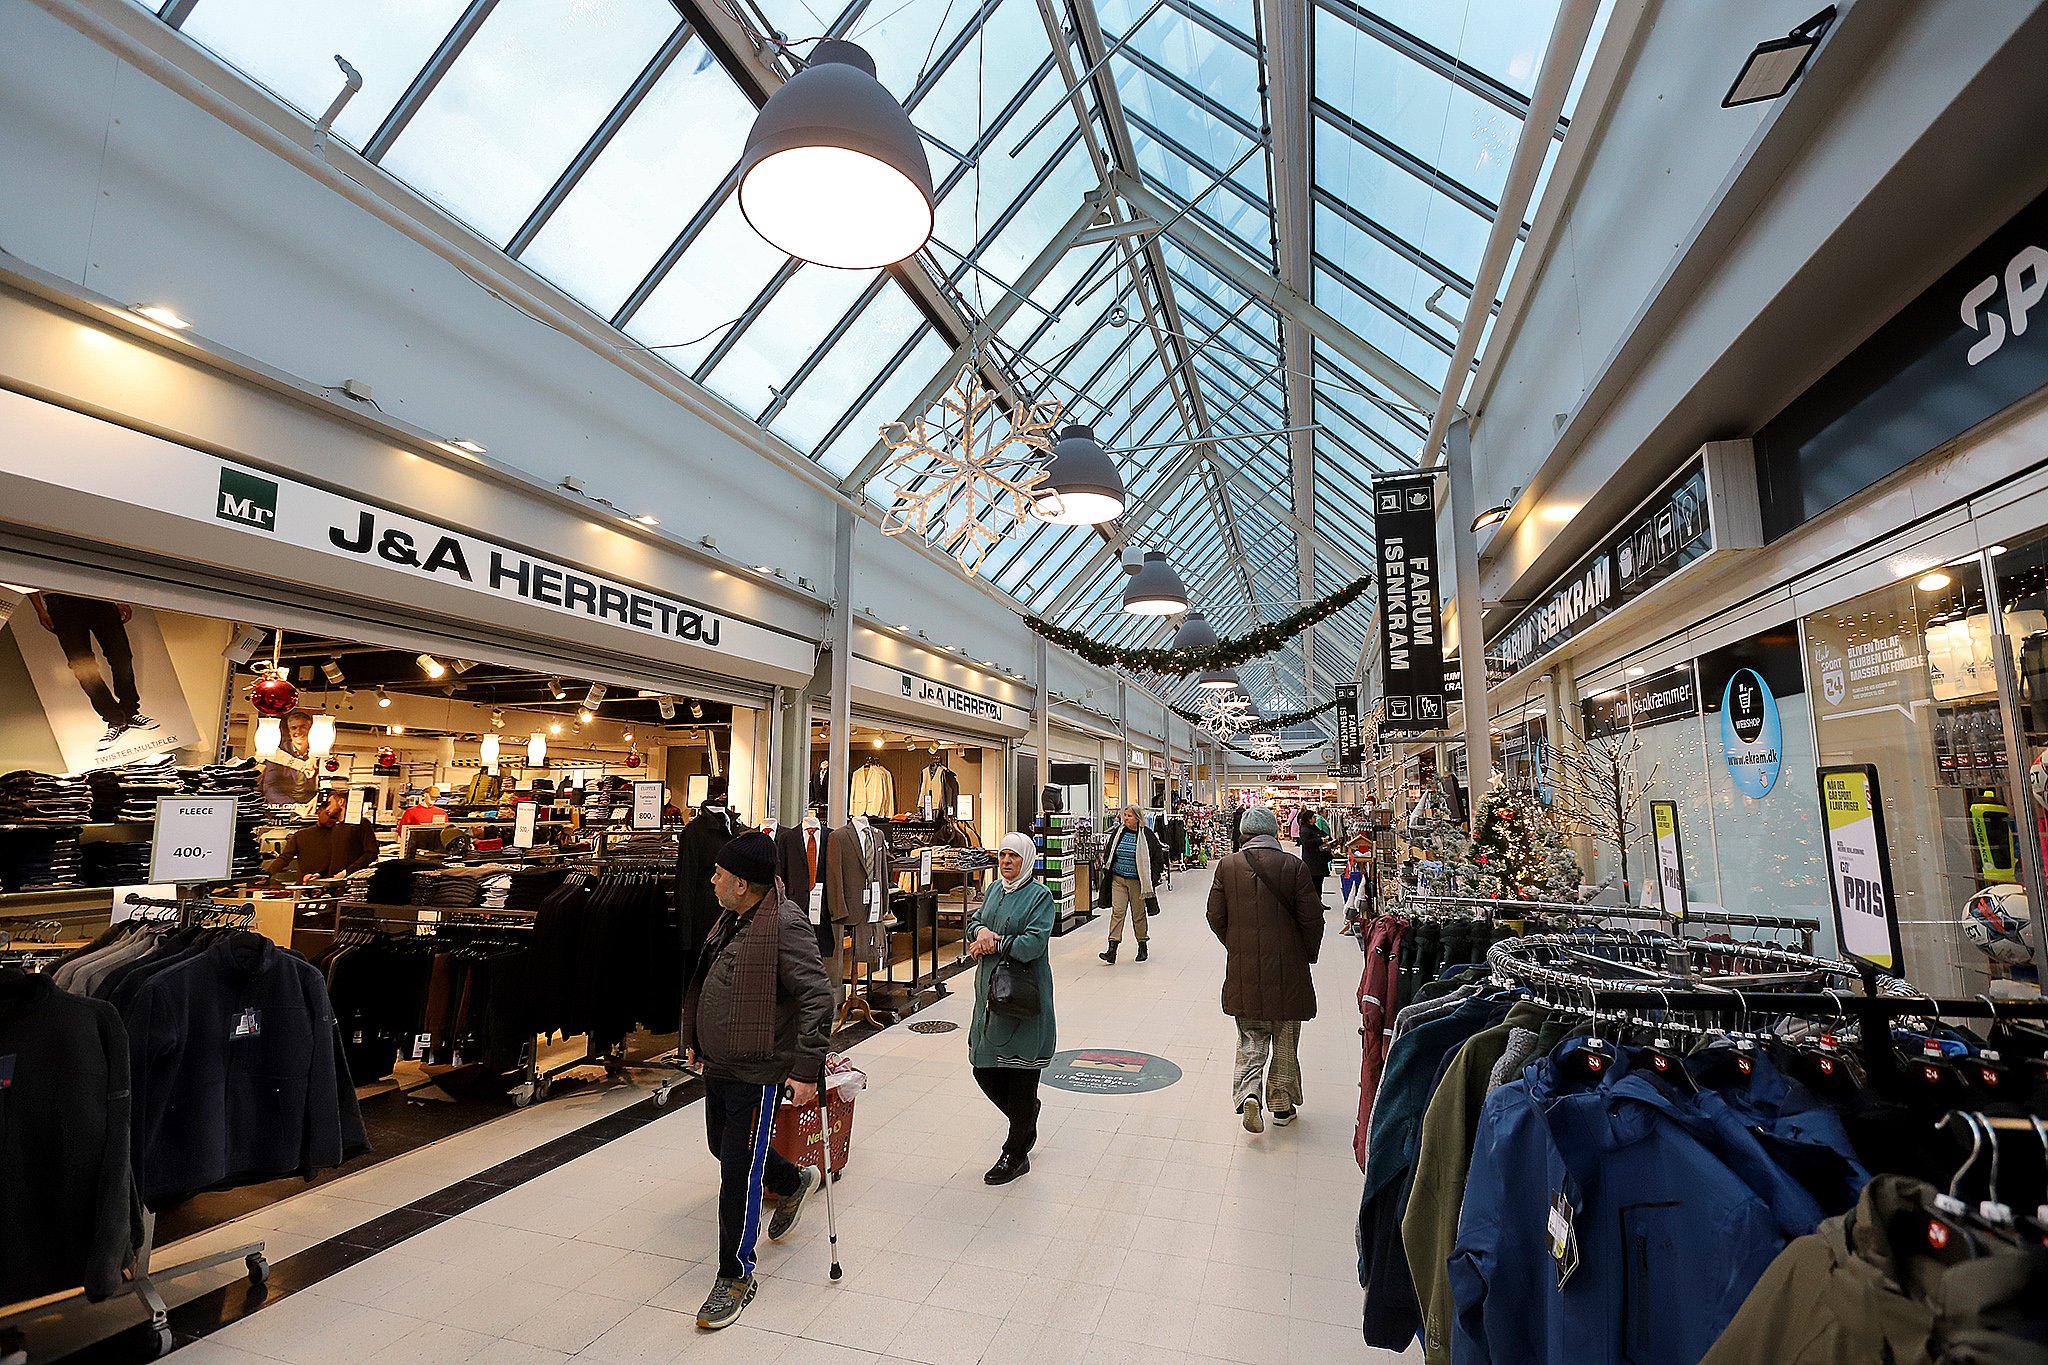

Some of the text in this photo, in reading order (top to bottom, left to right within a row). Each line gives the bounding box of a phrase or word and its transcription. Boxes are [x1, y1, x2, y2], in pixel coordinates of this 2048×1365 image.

[220, 491, 274, 524] Mr
[329, 510, 721, 647] J&A HERRETØJ
[1384, 537, 1409, 670] ISENKRAM
[1410, 557, 1433, 645] FARUM
[1502, 555, 1611, 670] FARUM ISENKRAM
[1875, 639, 1889, 650] DEL
[1889, 635, 1900, 647] AF
[1821, 658, 1842, 672] SPORT
[1849, 652, 1881, 670] KLUBBEN
[1882, 649, 1893, 661] OG
[1850, 665, 1880, 681] MASSER
[1881, 663, 1890, 675] AF
[1826, 676, 1843, 697] 24
[919, 682, 1002, 721] J&A HERRETØJ
[1616, 701, 1629, 719] Din
[1340, 707, 1349, 757] ISENKRAM
[1349, 714, 1357, 748] FARUM
[1736, 718, 1761, 730] WEBSHOP
[94, 735, 178, 765] TWISTER MULTIFLEX
[1728, 749, 1778, 766] www.ekram.dk
[1836, 780, 1846, 790] DER
[1838, 791, 1852, 800] SPORT
[179, 807, 213, 815] FLEECE
[1833, 801, 1843, 811] LAVE
[1843, 802, 1859, 811] PRISER
[173, 846, 212, 859] 400,-
[1843, 875, 1884, 918] PRIS
[1075, 1072, 1123, 1080] Gavekort
[806, 1128, 832, 1146] Neto
